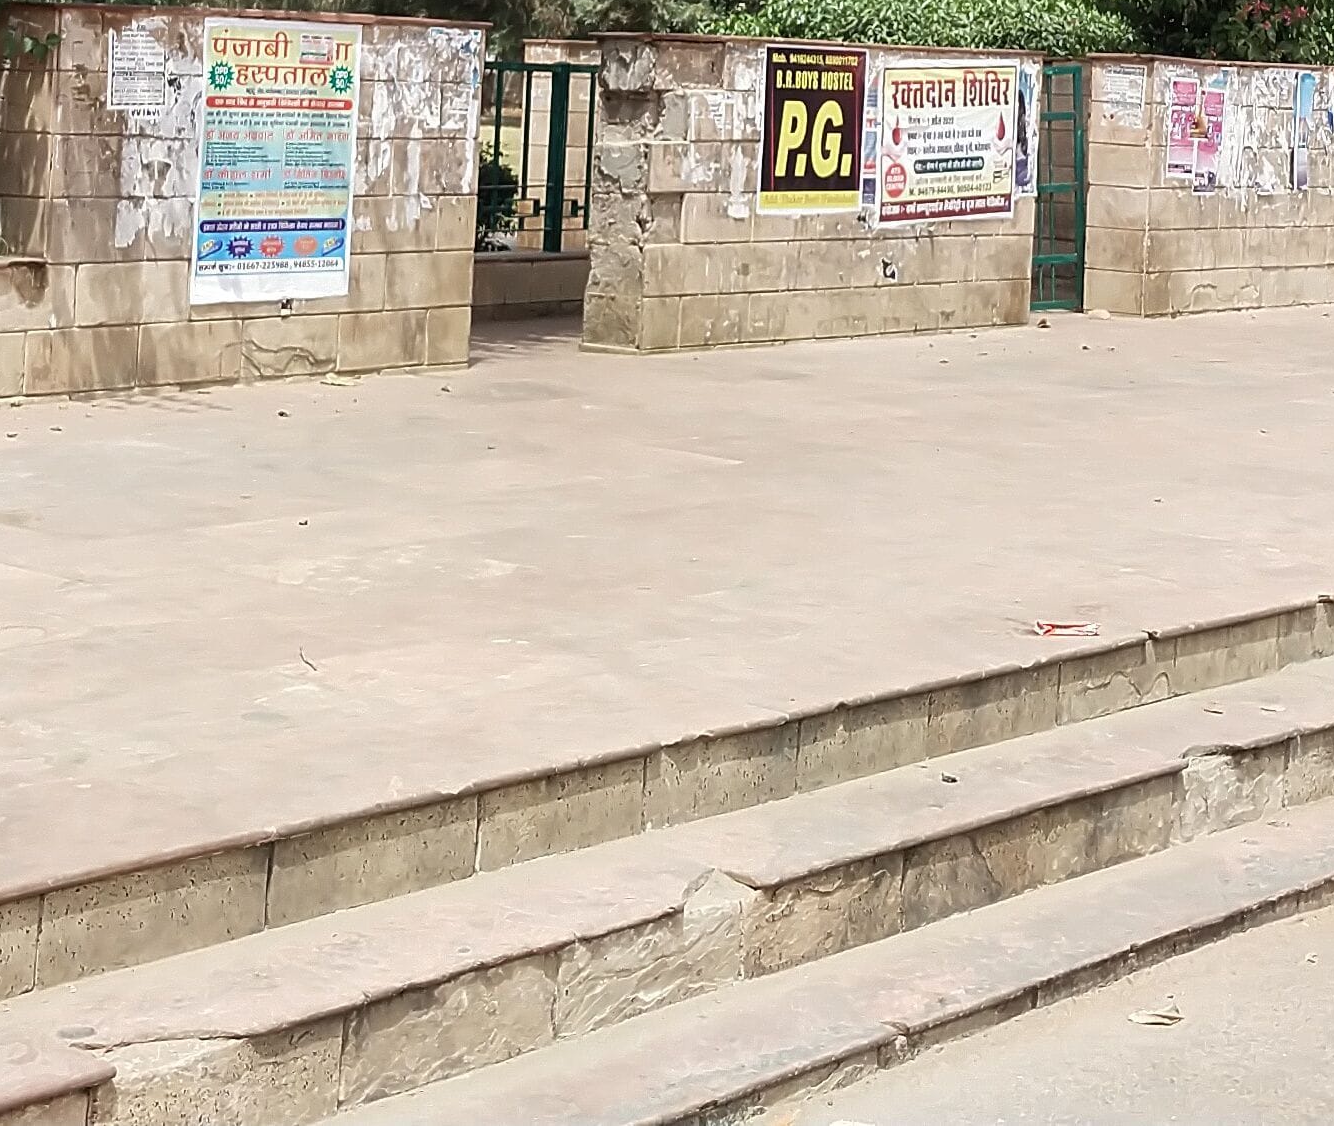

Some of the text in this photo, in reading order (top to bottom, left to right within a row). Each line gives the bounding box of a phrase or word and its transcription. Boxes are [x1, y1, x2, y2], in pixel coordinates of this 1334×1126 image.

[212, 29, 293, 58] पंजाबी
[235, 64, 330, 87] हस्पताल
[821, 71, 854, 91] HOSTEL
[891, 79, 956, 109] रक्तदान
[963, 70, 1010, 107] शिविर
[774, 100, 852, 177] P.G.
